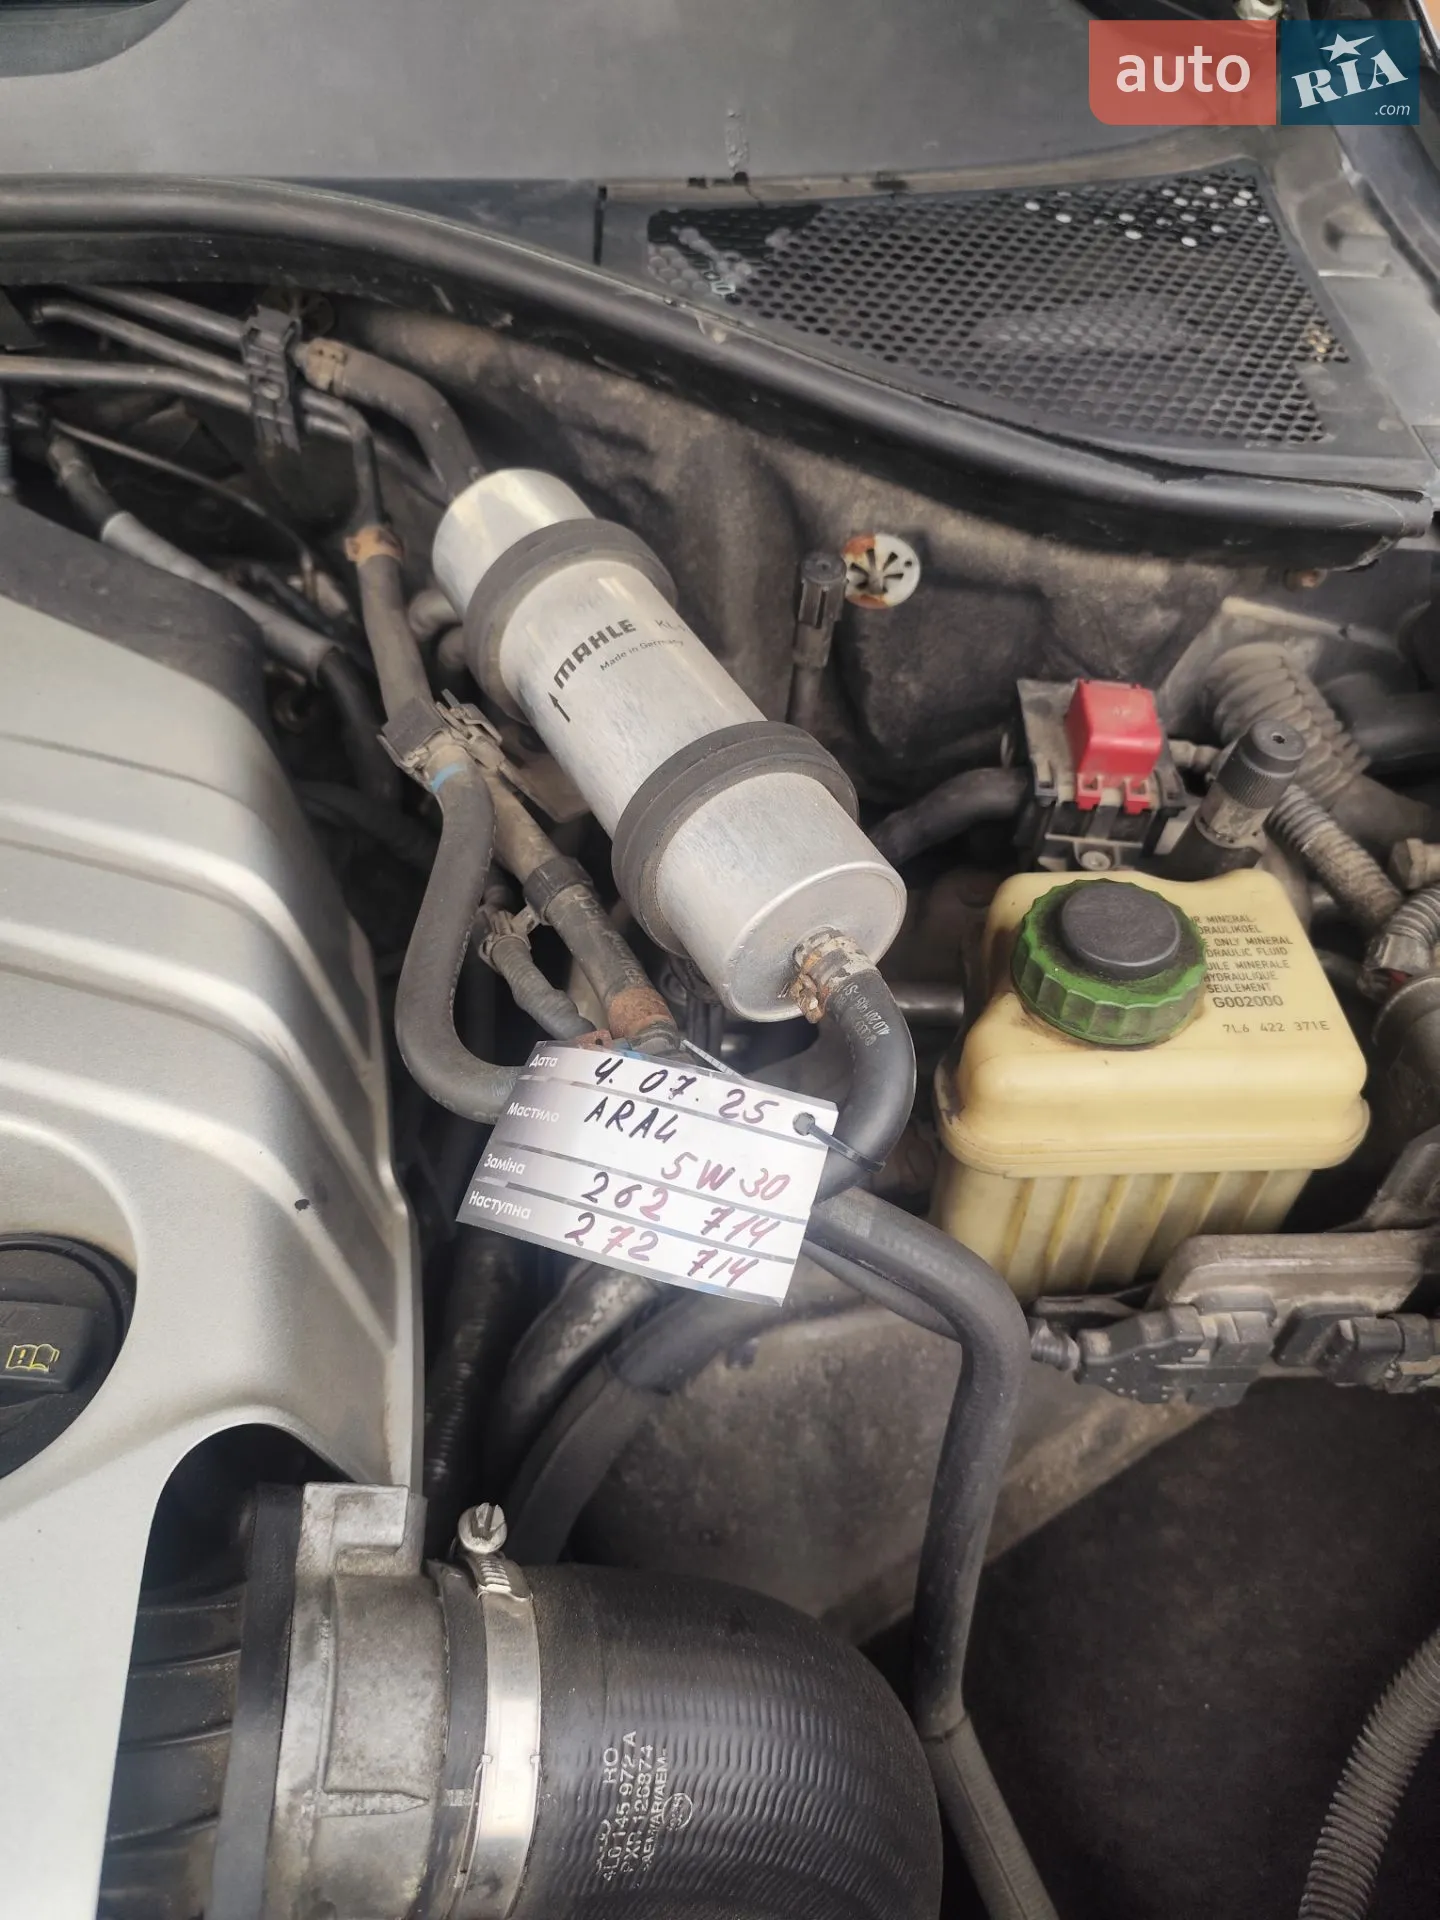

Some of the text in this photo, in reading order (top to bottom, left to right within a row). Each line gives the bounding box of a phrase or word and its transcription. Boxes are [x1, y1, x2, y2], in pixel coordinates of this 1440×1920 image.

[553, 619, 637, 690] MAHLE
[600, 652, 628, 671] Made
[1199, 925, 1262, 935] DRAULIKOEL
[1214, 937, 1240, 947] ONLY
[1245, 936, 1293, 945] MINERAL
[1206, 947, 1288, 958] DRAULIC FLUID
[1207, 960, 1290, 971] UILE MINERALE
[1206, 982, 1272, 993] SEULEMENT
[1260, 1022, 1285, 1032] 422
[1294, 1020, 1330, 1031] 371E
[529, 1053, 558, 1068] Дата
[506, 1101, 560, 1123] Мастило
[718, 1088, 779, 1125] 25
[483, 1153, 526, 1175] Заміна
[468, 1190, 531, 1220] Наступна
[581, 1171, 780, 1249] 262 714
[687, 1249, 760, 1287] 714
[622, 1730, 637, 1748] A
[618, 1753, 636, 1797] 972
[612, 1801, 631, 1838] 145
